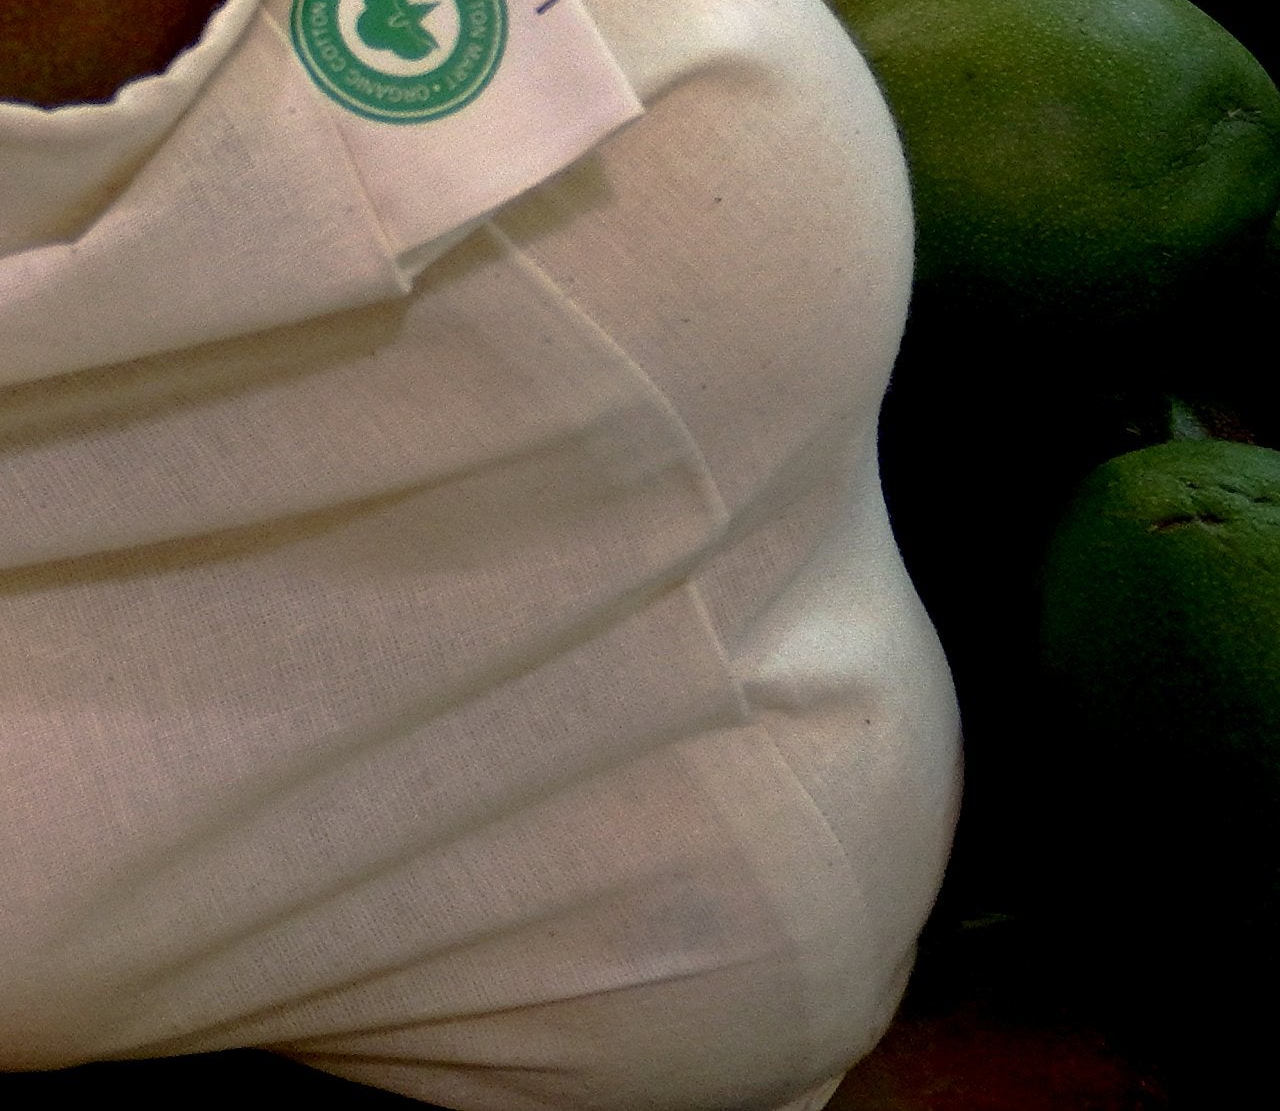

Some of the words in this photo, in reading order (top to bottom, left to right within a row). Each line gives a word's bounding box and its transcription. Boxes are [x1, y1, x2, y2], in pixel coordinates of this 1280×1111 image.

[311, 1, 346, 71] COTTON
[345, 68, 430, 103] ORGANIC
[444, 44, 482, 90] MART
